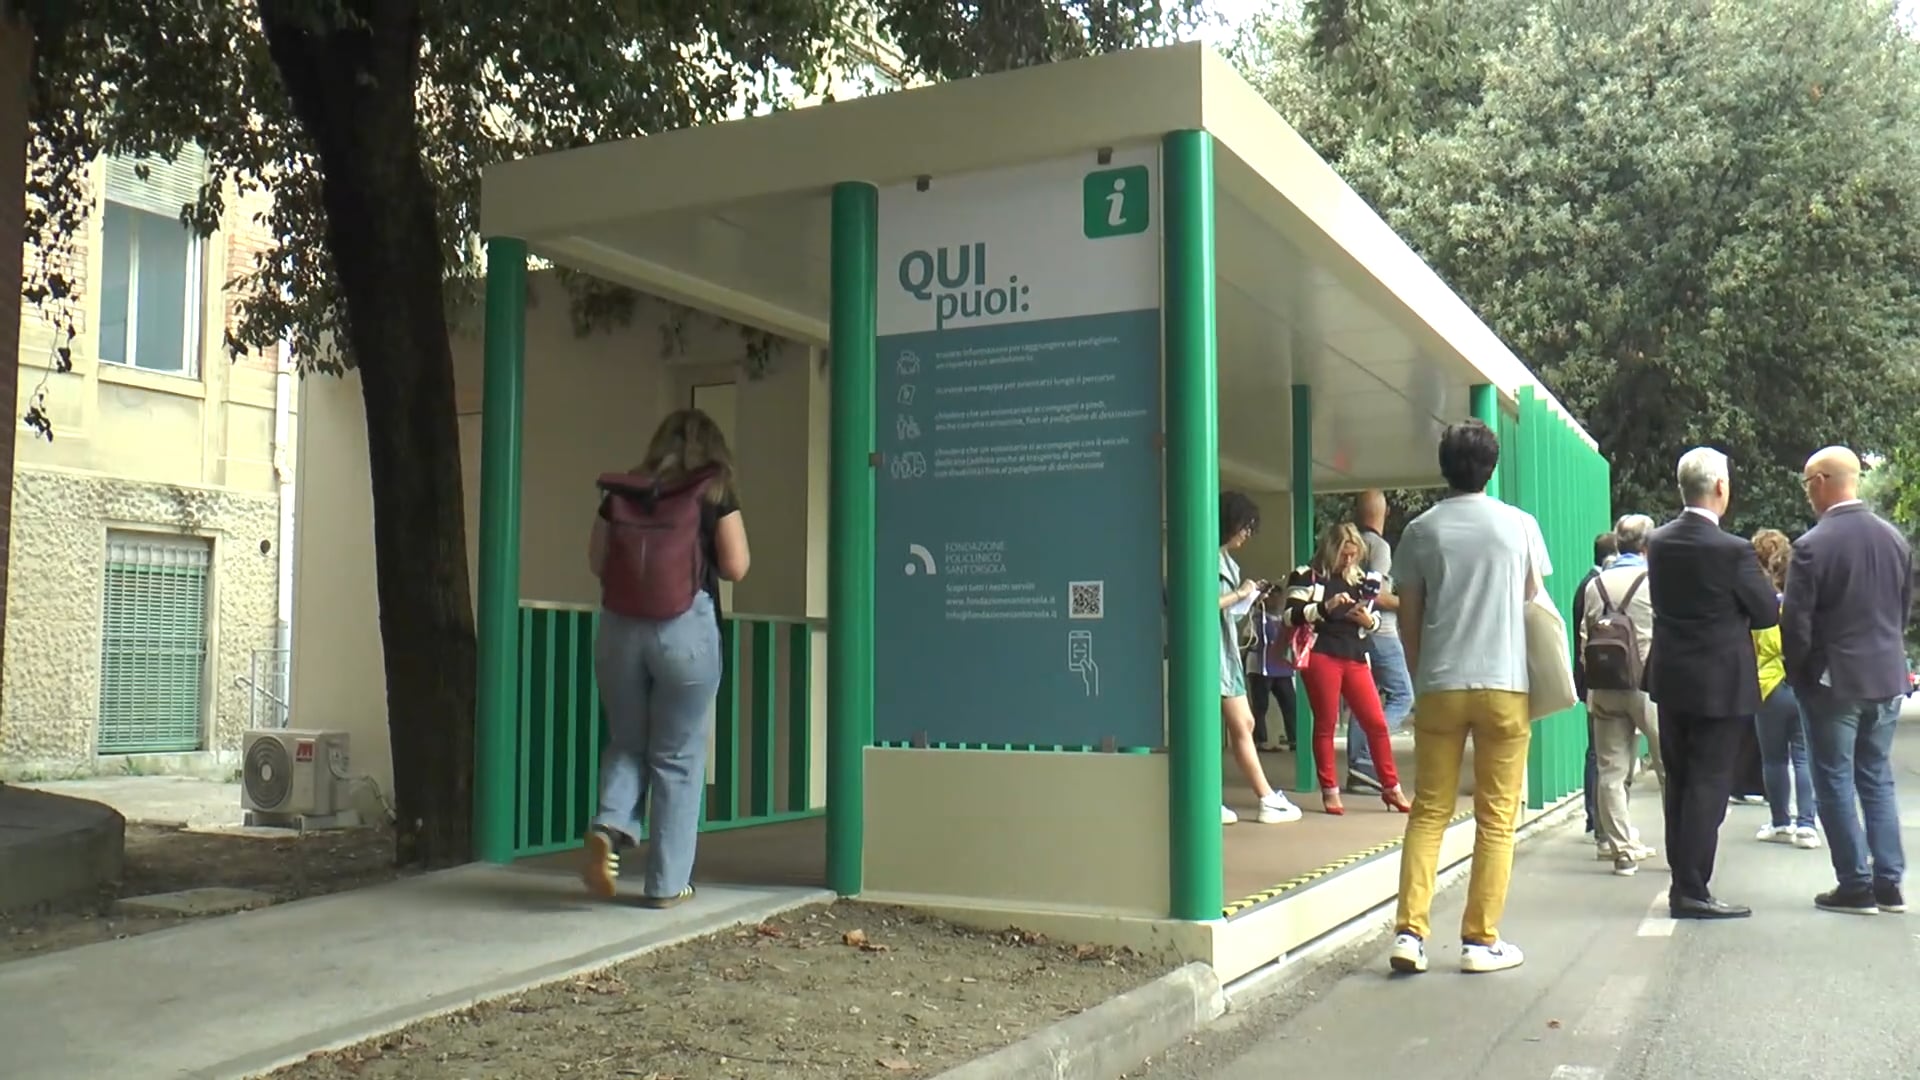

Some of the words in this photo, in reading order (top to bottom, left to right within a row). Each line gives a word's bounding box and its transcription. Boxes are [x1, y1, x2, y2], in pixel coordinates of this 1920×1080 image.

[899, 242, 986, 300] QUI
[936, 275, 1030, 330] puoi:
[945, 541, 1004, 552] FONDAZIONE
[945, 552, 1002, 563] POLICLINICO
[946, 583, 968, 593] Scopri
